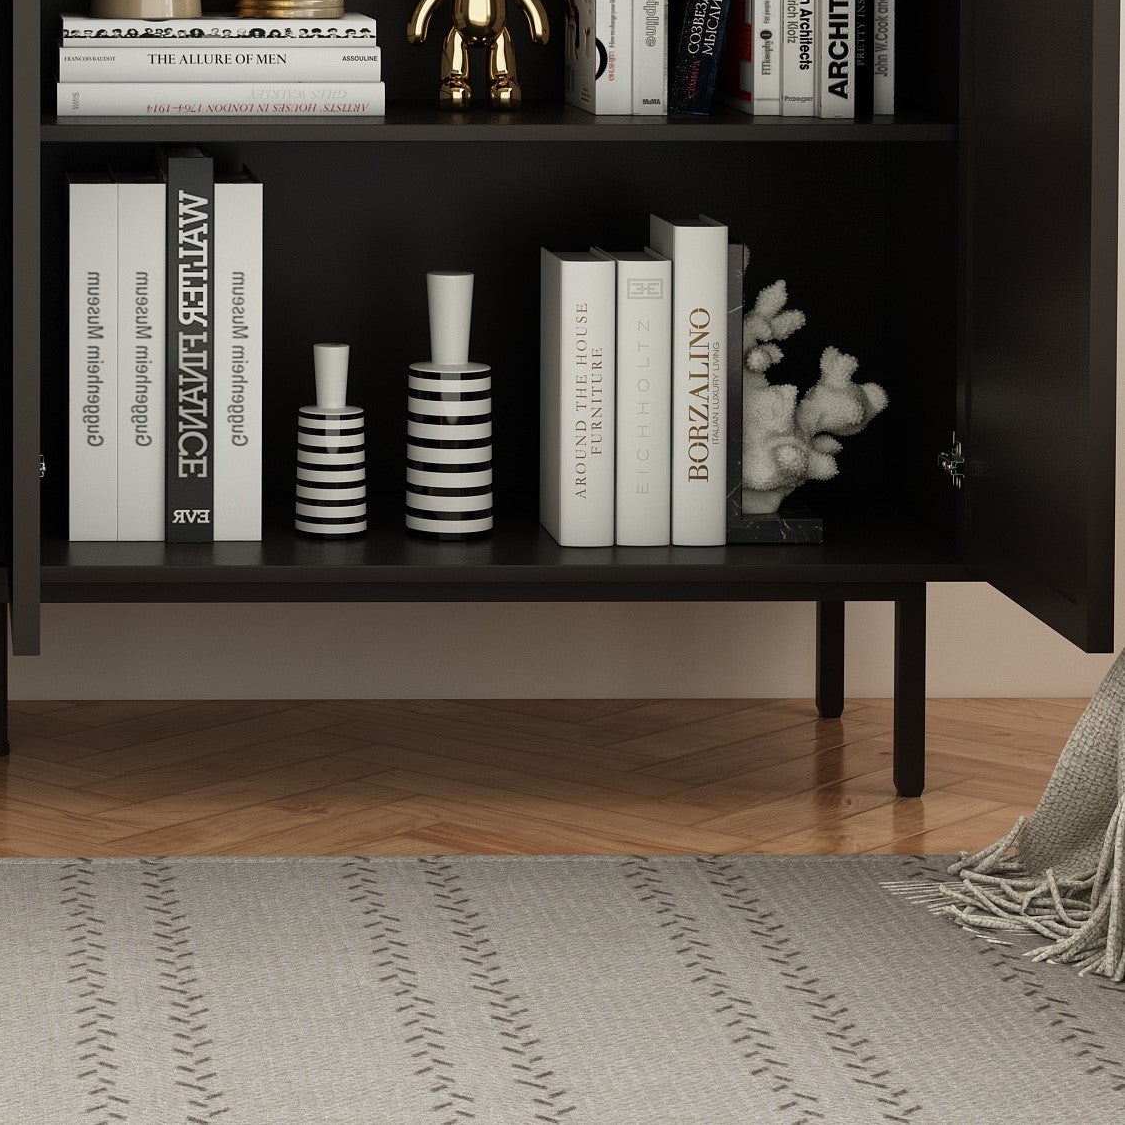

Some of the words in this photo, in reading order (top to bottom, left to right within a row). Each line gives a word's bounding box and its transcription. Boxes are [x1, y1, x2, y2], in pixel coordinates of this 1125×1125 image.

[787, 21, 798, 44] Klotz
[799, 8, 813, 71] Architects
[857, 21, 865, 66] PRETTY
[875, 16, 889, 52] W.Cook
[147, 53, 176, 65] THE
[179, 53, 232, 65] ALLURE
[234, 53, 254, 65] OF
[255, 53, 287, 65] MEN
[875, 53, 888, 78] John
[206, 103, 255, 113] LONDON
[258, 102, 270, 113] IN
[272, 102, 318, 113] HOUSES
[575, 302, 588, 366] HOUSE
[711, 342, 720, 372] LIVING
[575, 374, 588, 412] THE
[591, 347, 603, 456] FURNITURE
[636, 319, 650, 495] EICHHOLTZ
[687, 307, 711, 483] BORZALINO
[711, 373, 720, 410] LUXURY
[711, 412, 720, 445] ITALIAN
[575, 419, 588, 499] AROUND
